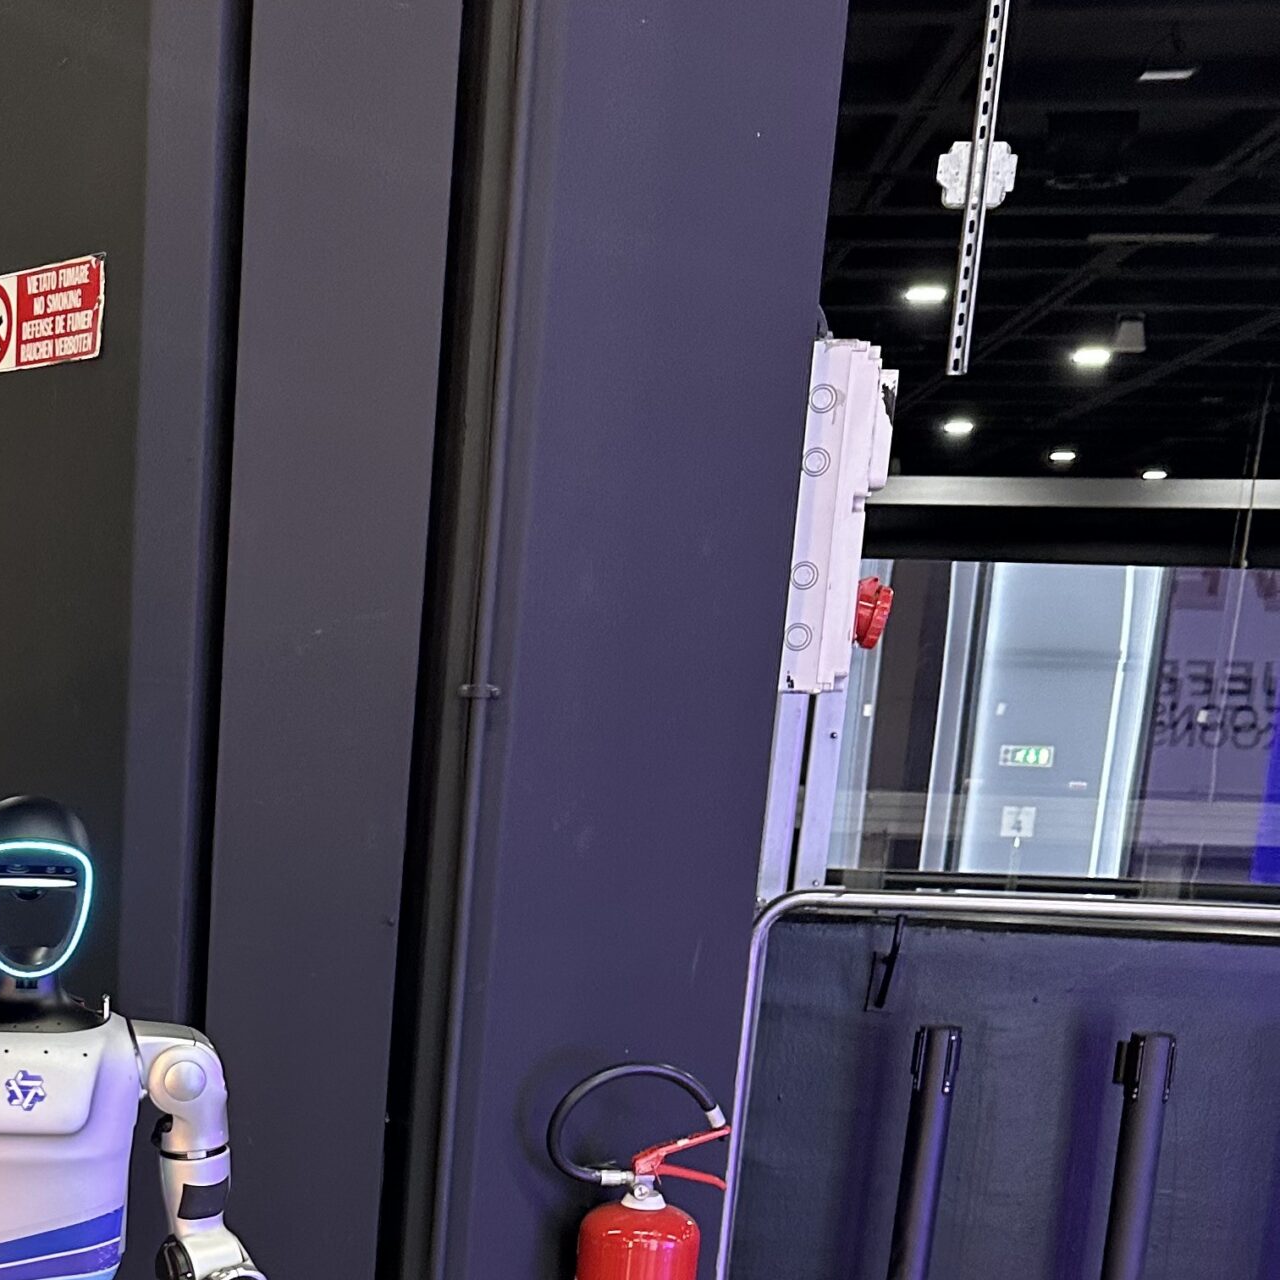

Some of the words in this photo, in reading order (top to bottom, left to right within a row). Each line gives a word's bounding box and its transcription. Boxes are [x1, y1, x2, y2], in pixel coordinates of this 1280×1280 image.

[27, 271, 57, 295] VETATO
[59, 264, 90, 288] FUMARE
[33, 295, 45, 316] NO
[46, 288, 82, 314] SMOKING
[22, 317, 53, 340] DEFENSE
[54, 314, 66, 335] DE
[67, 309, 94, 333] FUMER
[20, 338, 54, 363] RAUCHEN
[55, 332, 93, 357] VERBOTEN
